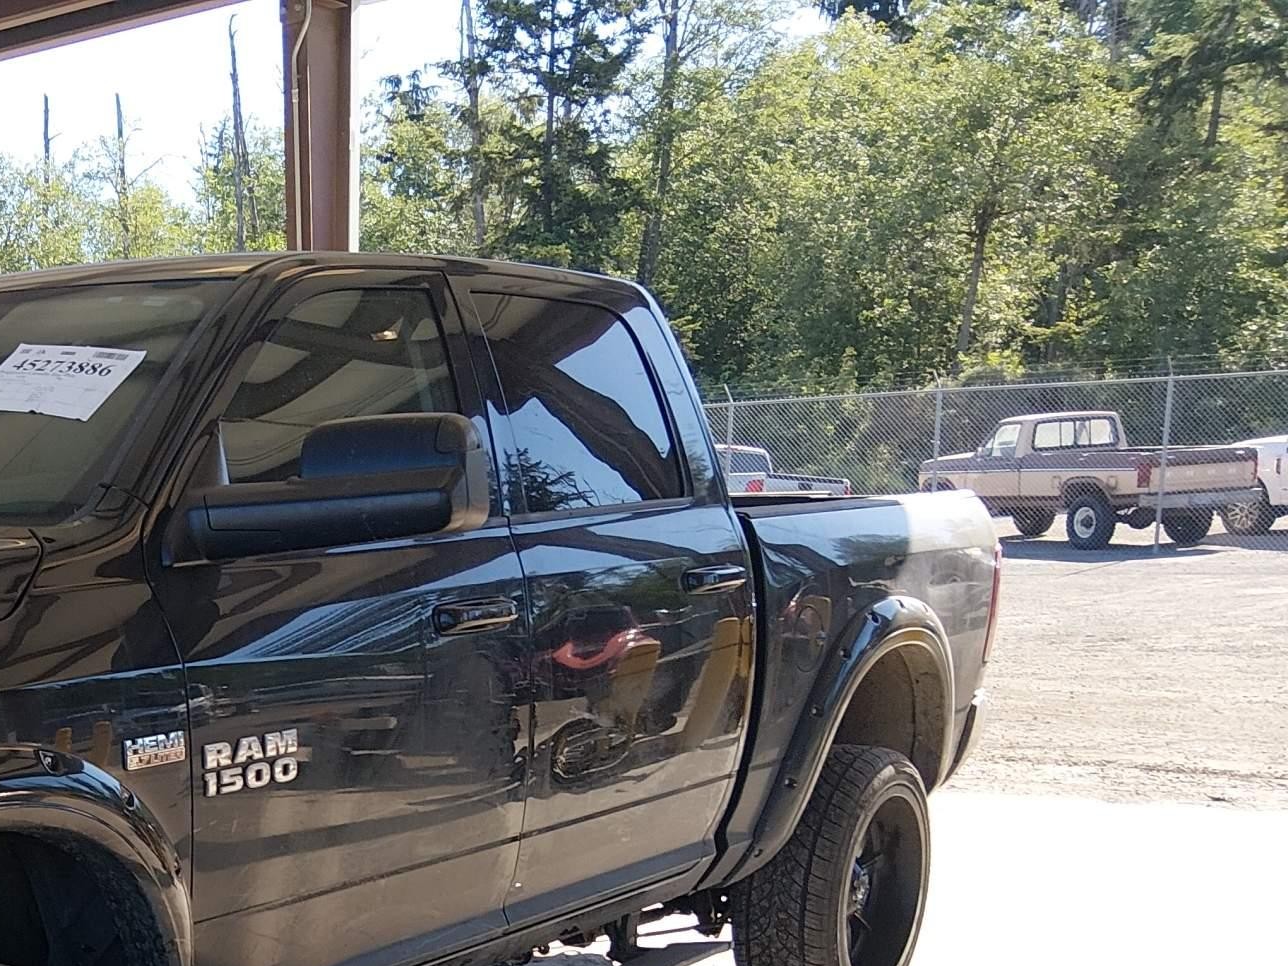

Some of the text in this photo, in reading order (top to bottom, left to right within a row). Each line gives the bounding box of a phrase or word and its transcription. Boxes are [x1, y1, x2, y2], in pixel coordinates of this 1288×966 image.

[12, 358, 116, 377] 45273886
[125, 731, 185, 756] HEMI
[203, 728, 298, 770] RAM
[204, 757, 298, 797] 1500
